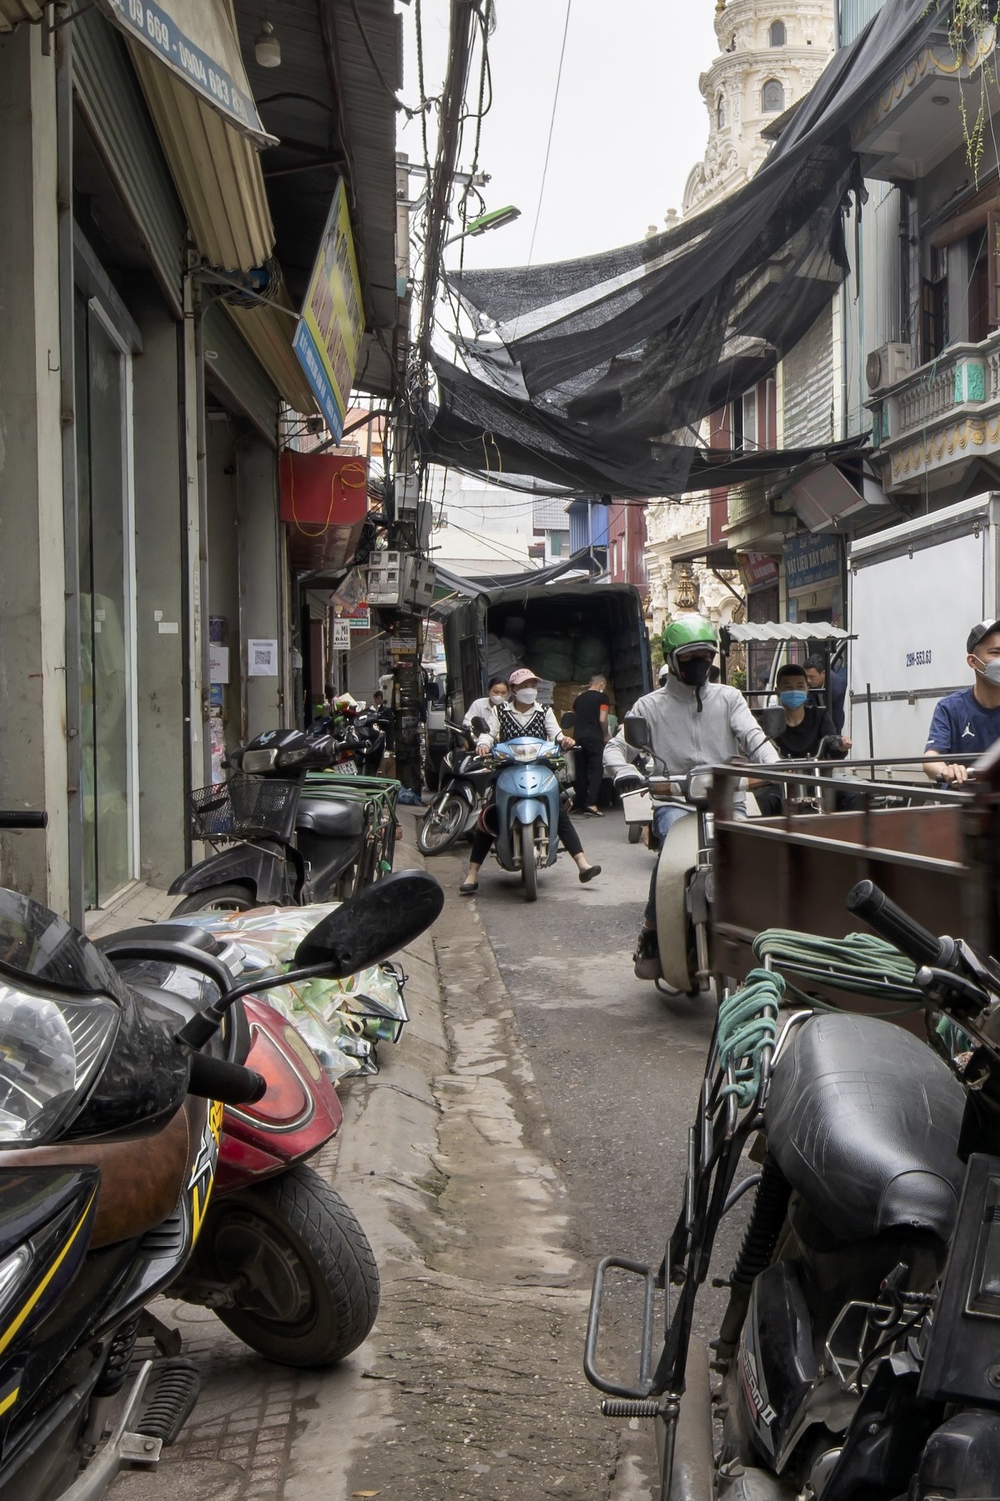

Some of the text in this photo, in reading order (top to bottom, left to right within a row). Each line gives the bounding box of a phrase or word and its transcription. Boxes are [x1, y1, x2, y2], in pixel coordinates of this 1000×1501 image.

[146, 9, 170, 51] 669
[178, 40, 207, 85] 0904
[208, 67, 230, 106] 683
